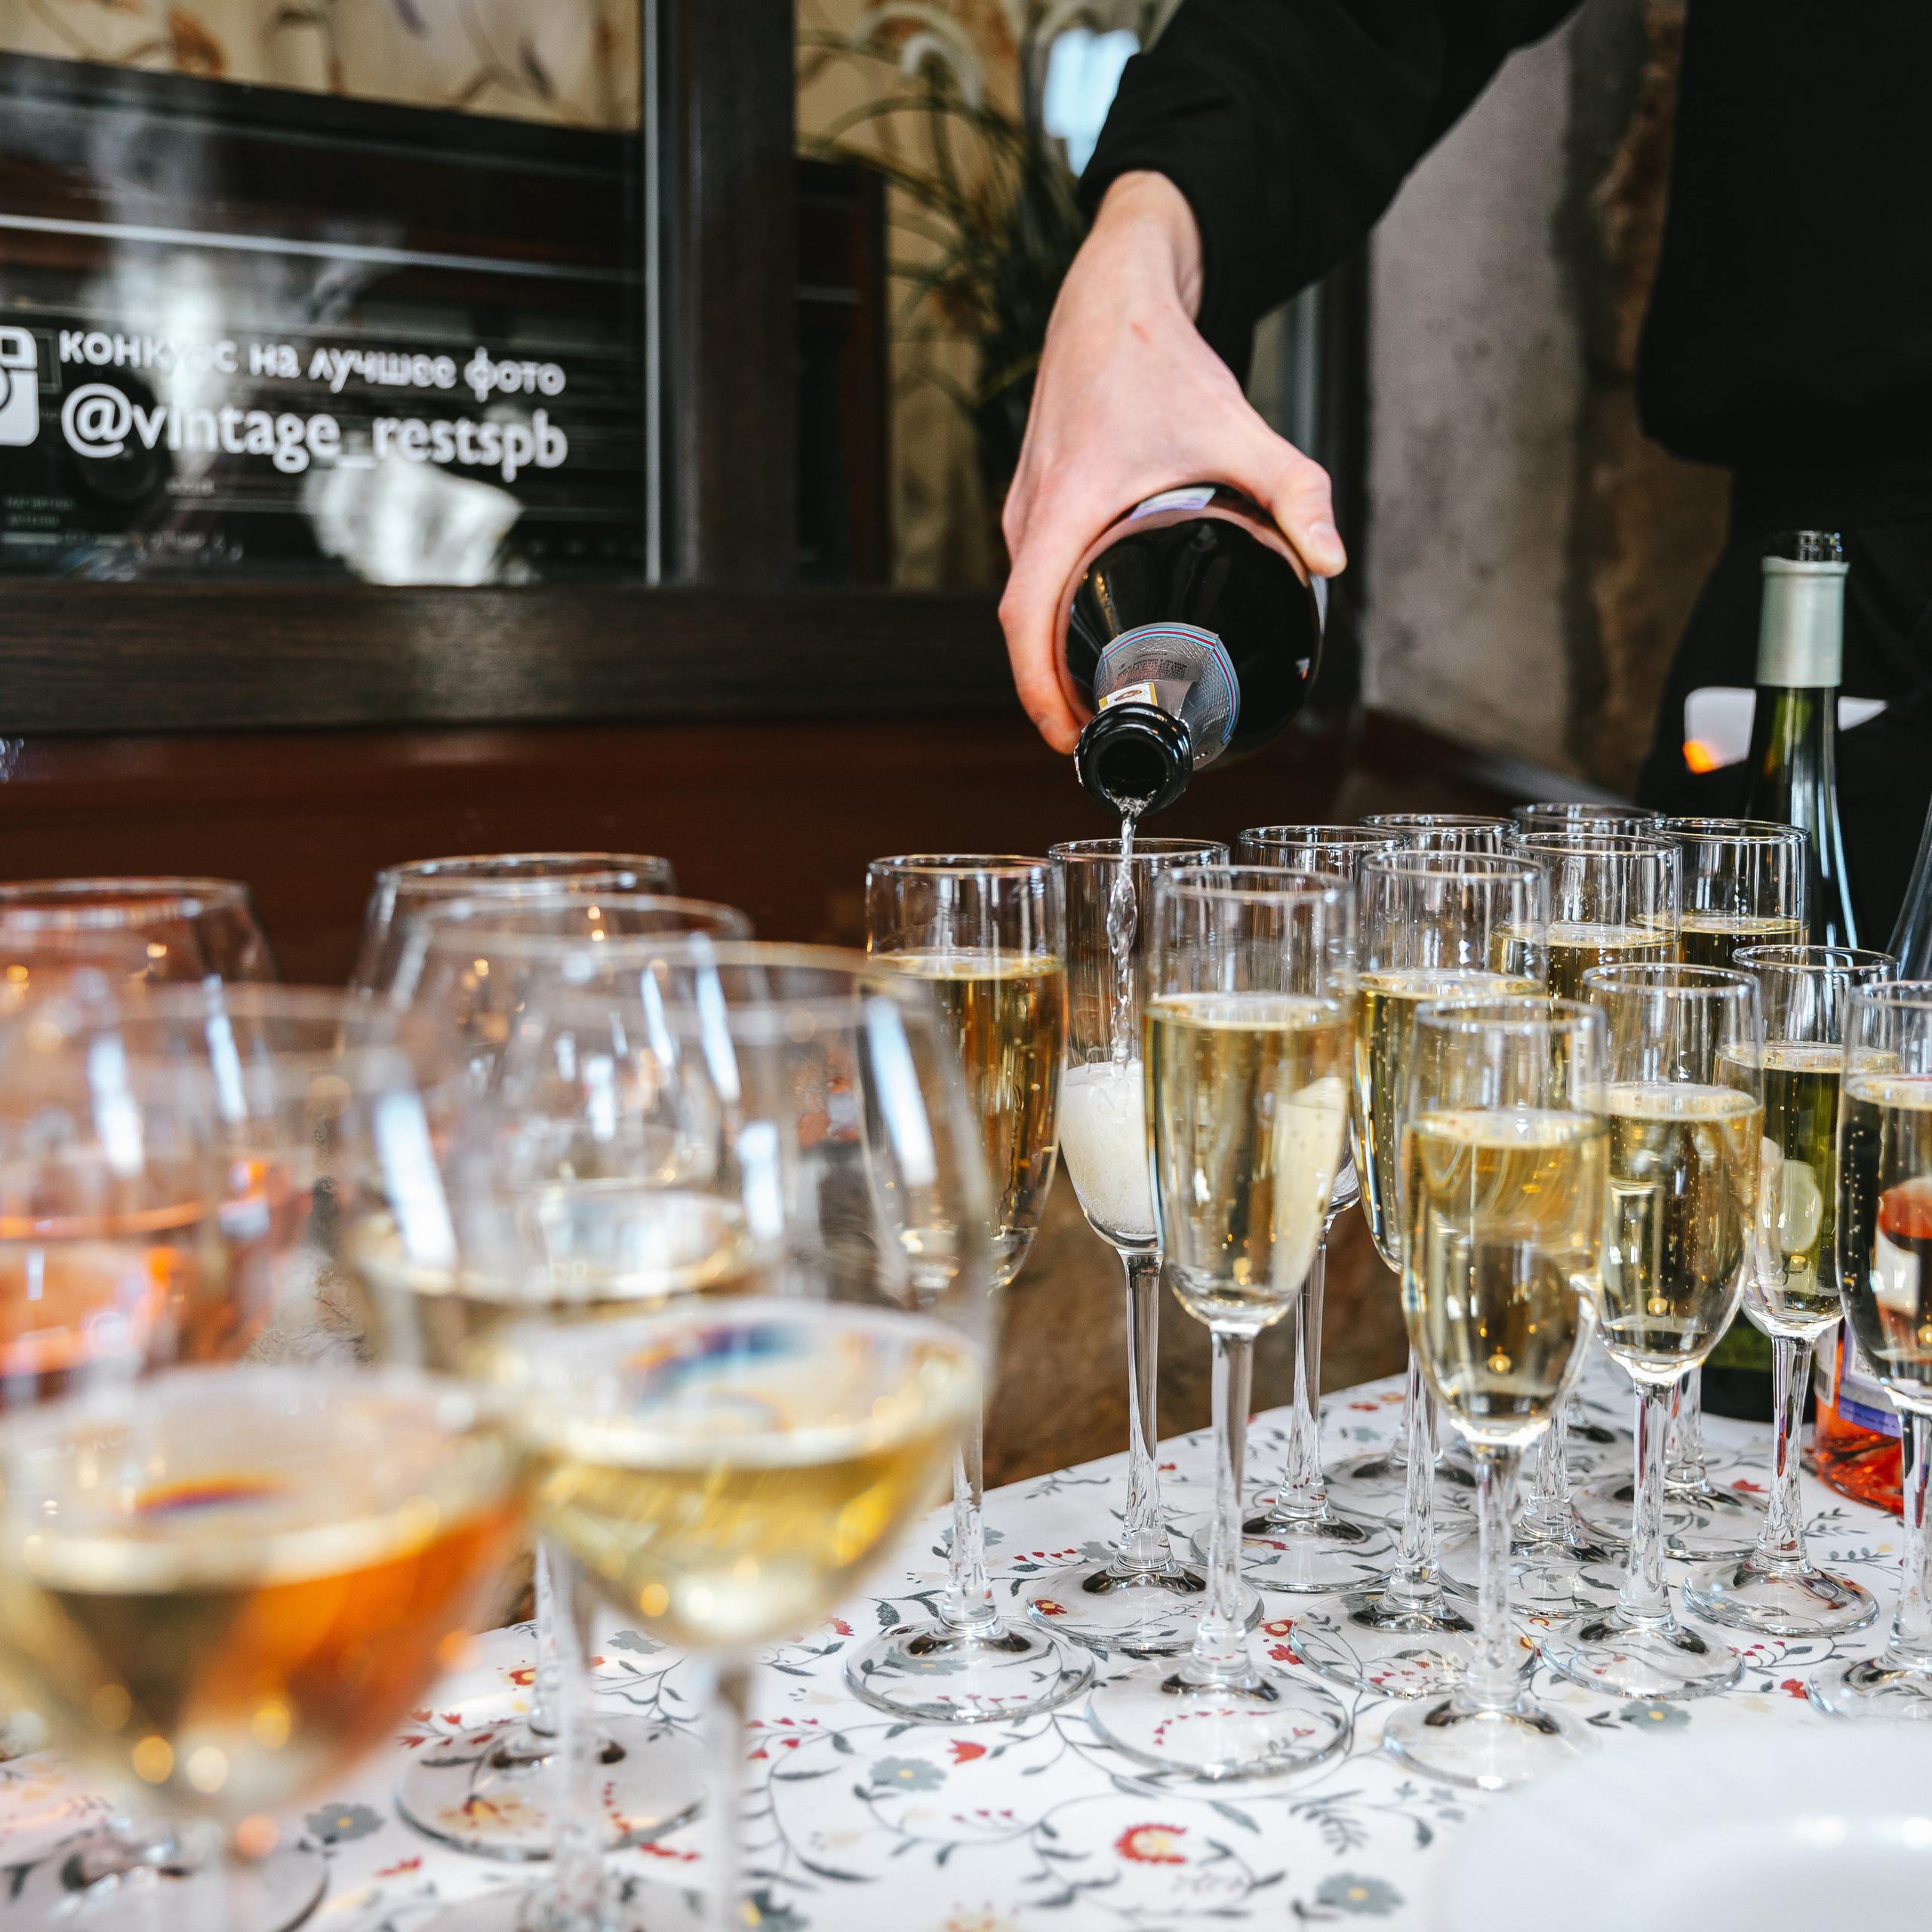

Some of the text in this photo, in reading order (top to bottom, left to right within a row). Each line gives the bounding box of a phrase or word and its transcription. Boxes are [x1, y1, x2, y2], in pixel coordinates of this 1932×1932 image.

[59, 330, 566, 402] конкс на лучшее фото
[61, 383, 568, 483] @vintage_restspb
